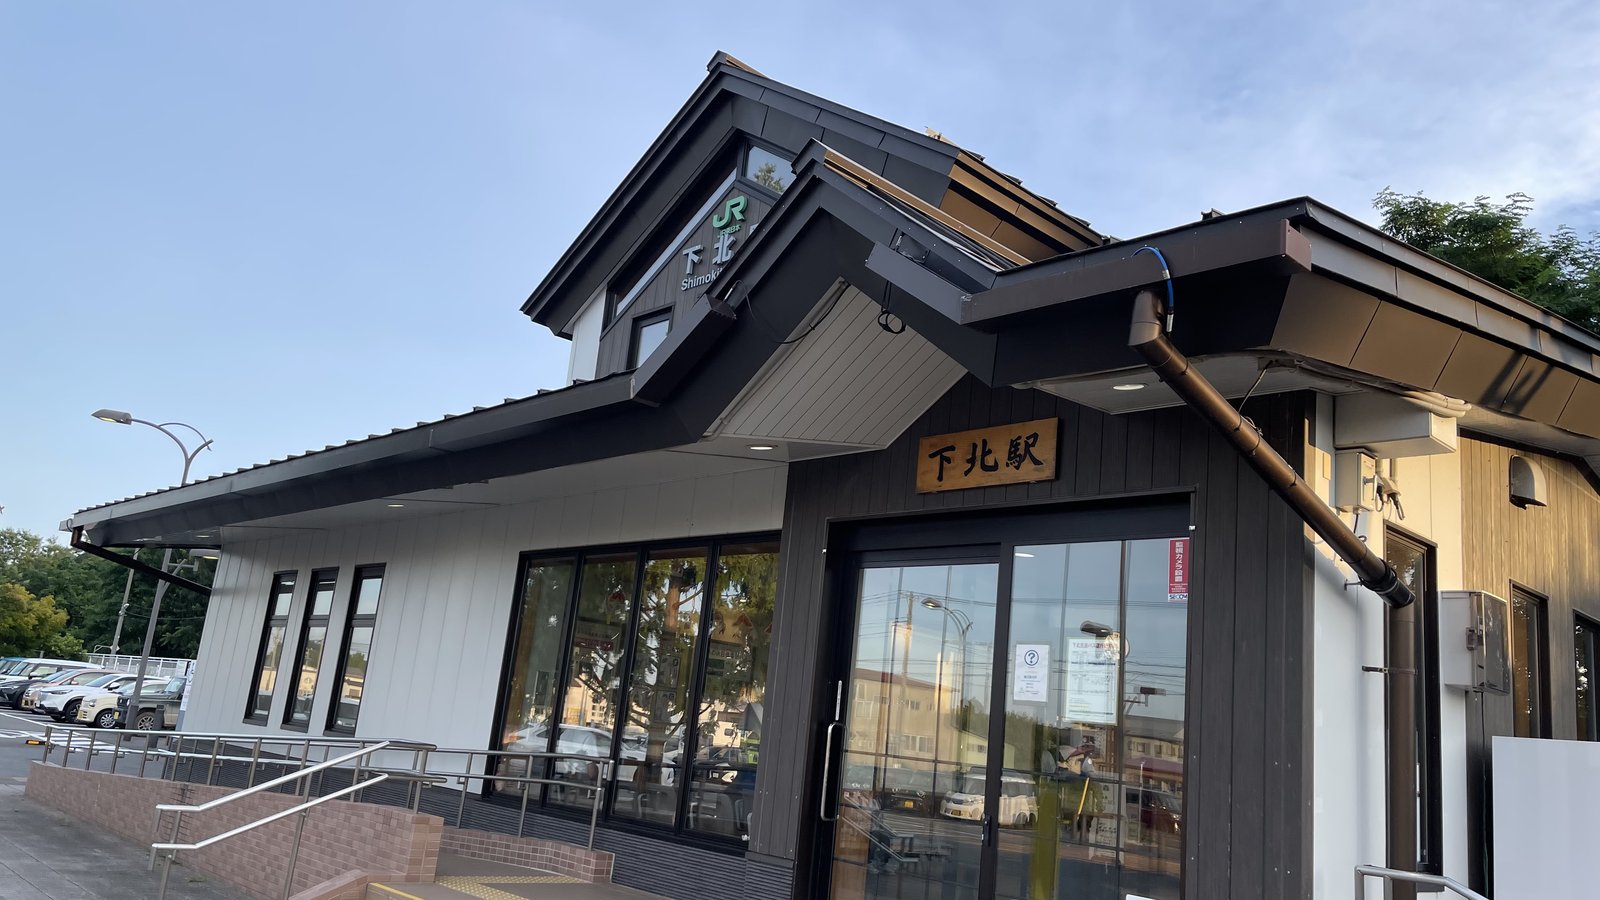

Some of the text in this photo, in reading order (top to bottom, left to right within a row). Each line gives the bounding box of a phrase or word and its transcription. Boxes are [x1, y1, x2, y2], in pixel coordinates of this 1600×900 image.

[712, 195, 747, 228] JR
[928, 431, 1044, 482] 下北駅
